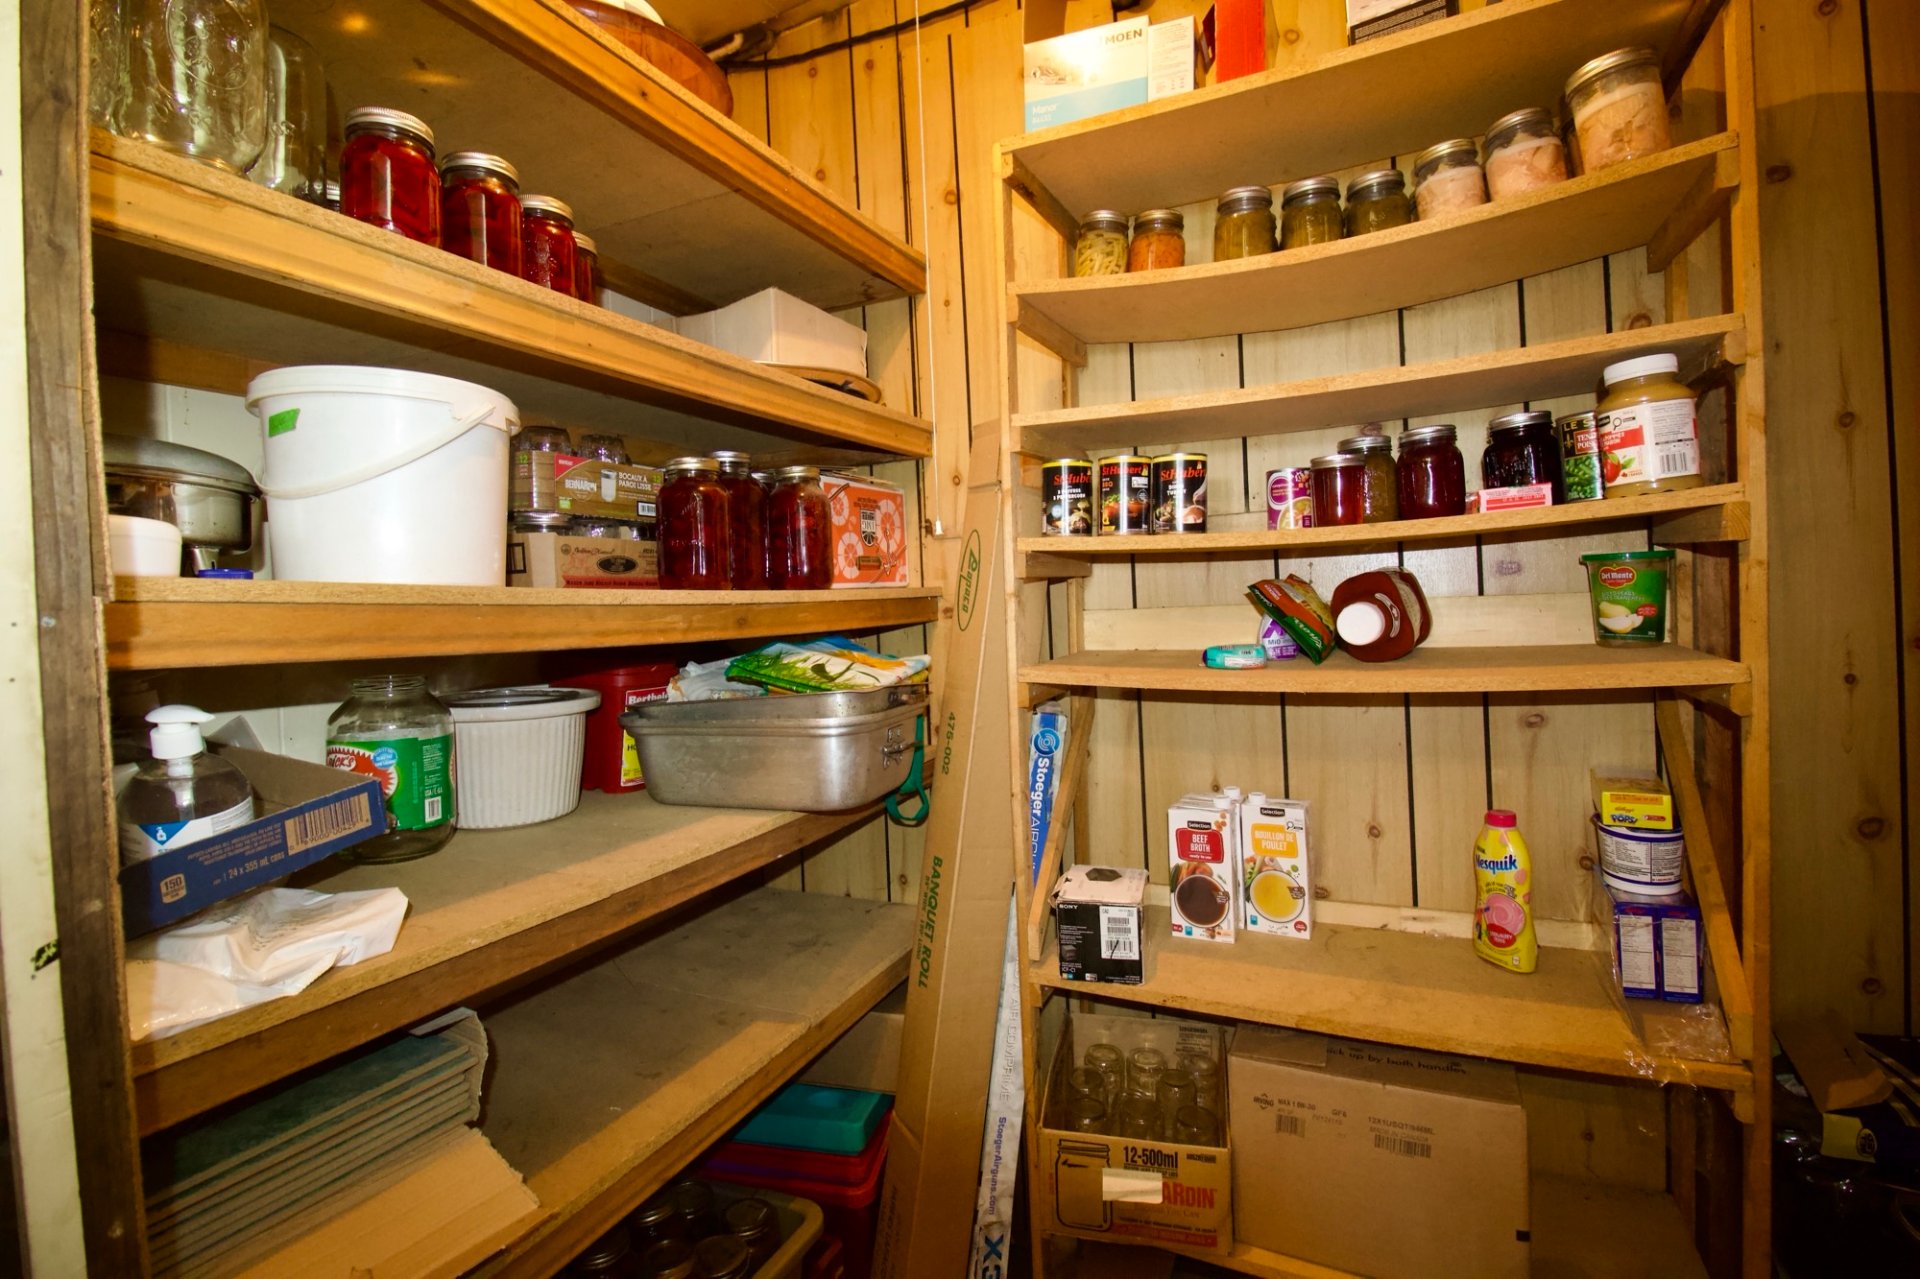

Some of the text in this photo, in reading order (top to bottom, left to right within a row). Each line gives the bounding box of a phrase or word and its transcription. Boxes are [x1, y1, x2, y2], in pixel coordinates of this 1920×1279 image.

[1105, 28, 1143, 45] MOEN
[1563, 421, 1578, 431] LE
[941, 711, 957, 776] 475-002
[1031, 756, 1050, 816] Stoeger
[1192, 834, 1208, 843] BEEF
[1255, 830, 1285, 840] BOUILLON
[1190, 842, 1211, 853] BROTH
[1261, 840, 1287, 851] POULET
[228, 866, 238, 880] 24
[244, 860, 258, 873] 355
[1475, 854, 1518, 875] Nesquik
[164, 877, 182, 890] 150
[916, 855, 944, 989] BANQUET ROLL
[988, 1116, 1008, 1216] StoegerAirguns.com
[1123, 1145, 1178, 1169] 12-500ml
